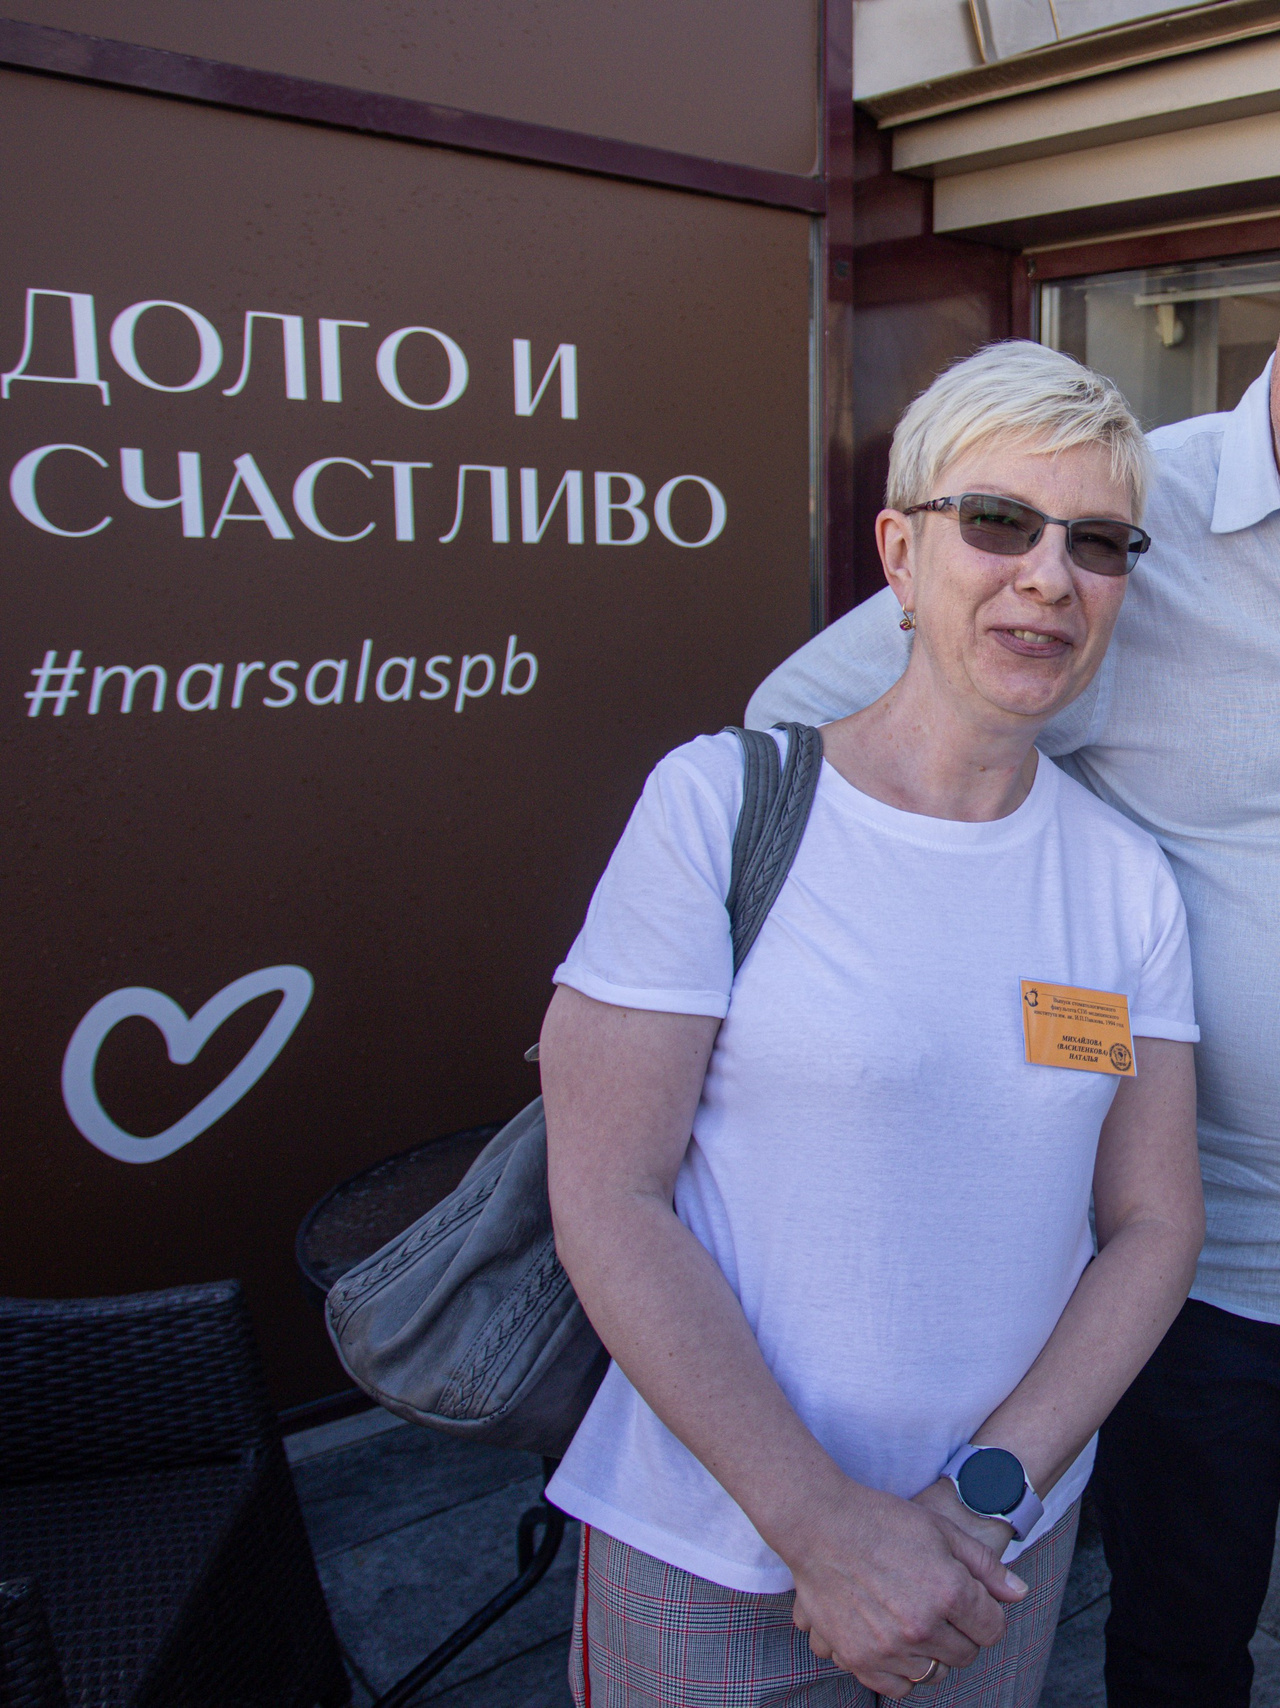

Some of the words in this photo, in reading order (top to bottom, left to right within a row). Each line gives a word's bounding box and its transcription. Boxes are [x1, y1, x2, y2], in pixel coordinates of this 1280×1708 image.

[1, 287, 469, 412] ДОЛГО
[512, 338, 579, 420] И
[9, 443, 728, 548] СЧАСТЛИВО
[25, 634, 539, 718] #marsalaspb
[1057, 1043, 1108, 1056] (ВАСИЛЕНКОВА)
[1062, 1034, 1102, 1045] МИХАЙЛОВА
[1069, 1052, 1098, 1062] НАТАЛЬЯ
